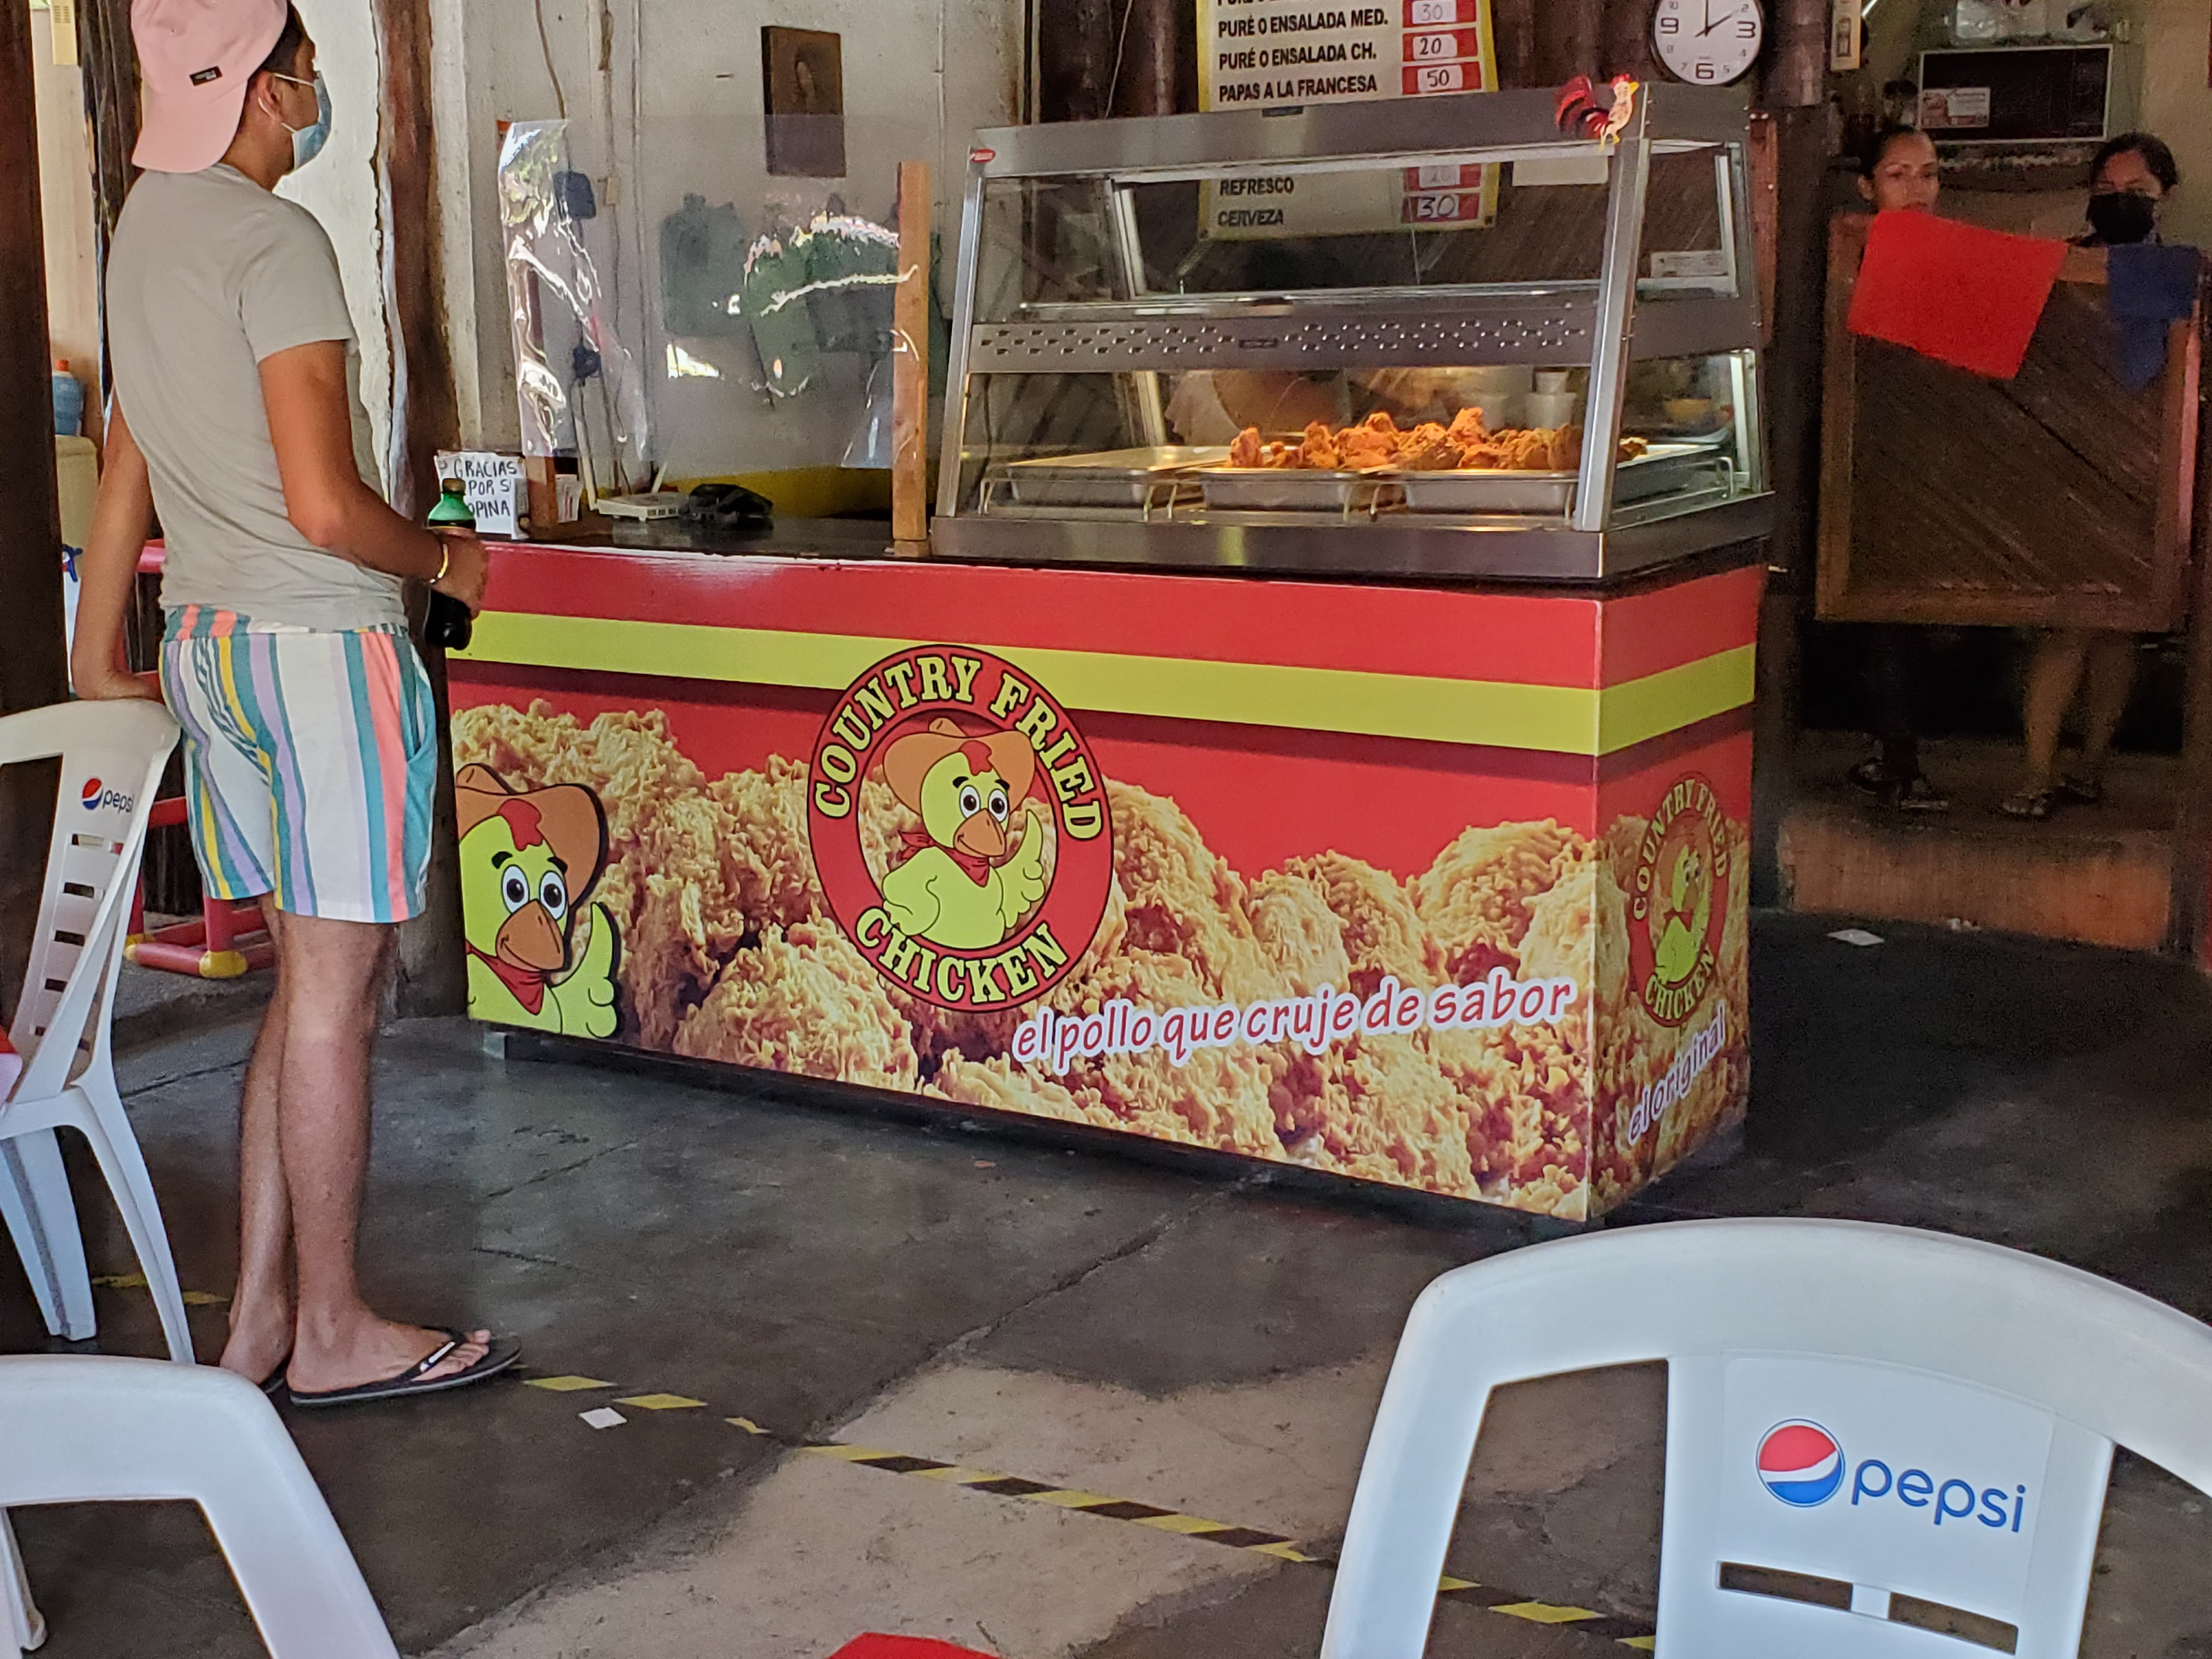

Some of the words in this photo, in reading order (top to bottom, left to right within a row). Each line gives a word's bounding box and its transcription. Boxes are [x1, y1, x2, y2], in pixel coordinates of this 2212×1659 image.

[1421, 4, 1443, 21] 30
[1741, 4, 1749, 13] 2
[1218, 14, 1255, 38] PURÉ
[1258, 18, 1267, 35] O
[1270, 11, 1346, 34] ENSALADA
[1351, 9, 1388, 27] MED.
[1660, 17, 1679, 34] 9
[1736, 20, 1756, 38] 3
[1219, 47, 1256, 70] PURÉ
[1259, 50, 1269, 67] O
[1272, 44, 1347, 66] ENSALADA
[1351, 42, 1377, 60] CH.
[1419, 37, 1442, 55] 20
[1427, 69, 1449, 87] 50
[1696, 63, 1714, 80] 6
[1723, 65, 1730, 74] 5
[1219, 82, 1260, 103] PAPAS
[1263, 82, 1274, 99] A
[1277, 80, 1294, 98] LA
[1297, 74, 1378, 97] FRANCESA
[1220, 177, 1295, 196] REFRESCO
[1421, 195, 1456, 217] 30
[1217, 208, 1284, 227] CERVEZA
[454, 458, 517, 479] GRACIAS
[469, 479, 495, 496] POR
[814, 656, 982, 819] COUNTRY
[989, 672, 1103, 841] FRIED
[102, 789, 135, 815] pepsi
[1634, 779, 1695, 919] COUNTRY
[1696, 782, 1728, 877] FRIED
[855, 906, 1068, 1004] CHICKEN
[1645, 943, 1714, 1020] CHICKEN
[1016, 1012, 1049, 1056] el
[1058, 1005, 1152, 1070] pollo
[1162, 1009, 1235, 1061] que
[1245, 989, 1355, 1048] cruje
[1365, 983, 1420, 1029] de
[1433, 974, 1571, 1024] sabor
[1653, 1003, 1725, 1116] original
[1850, 1458, 2026, 1533] pepsi
